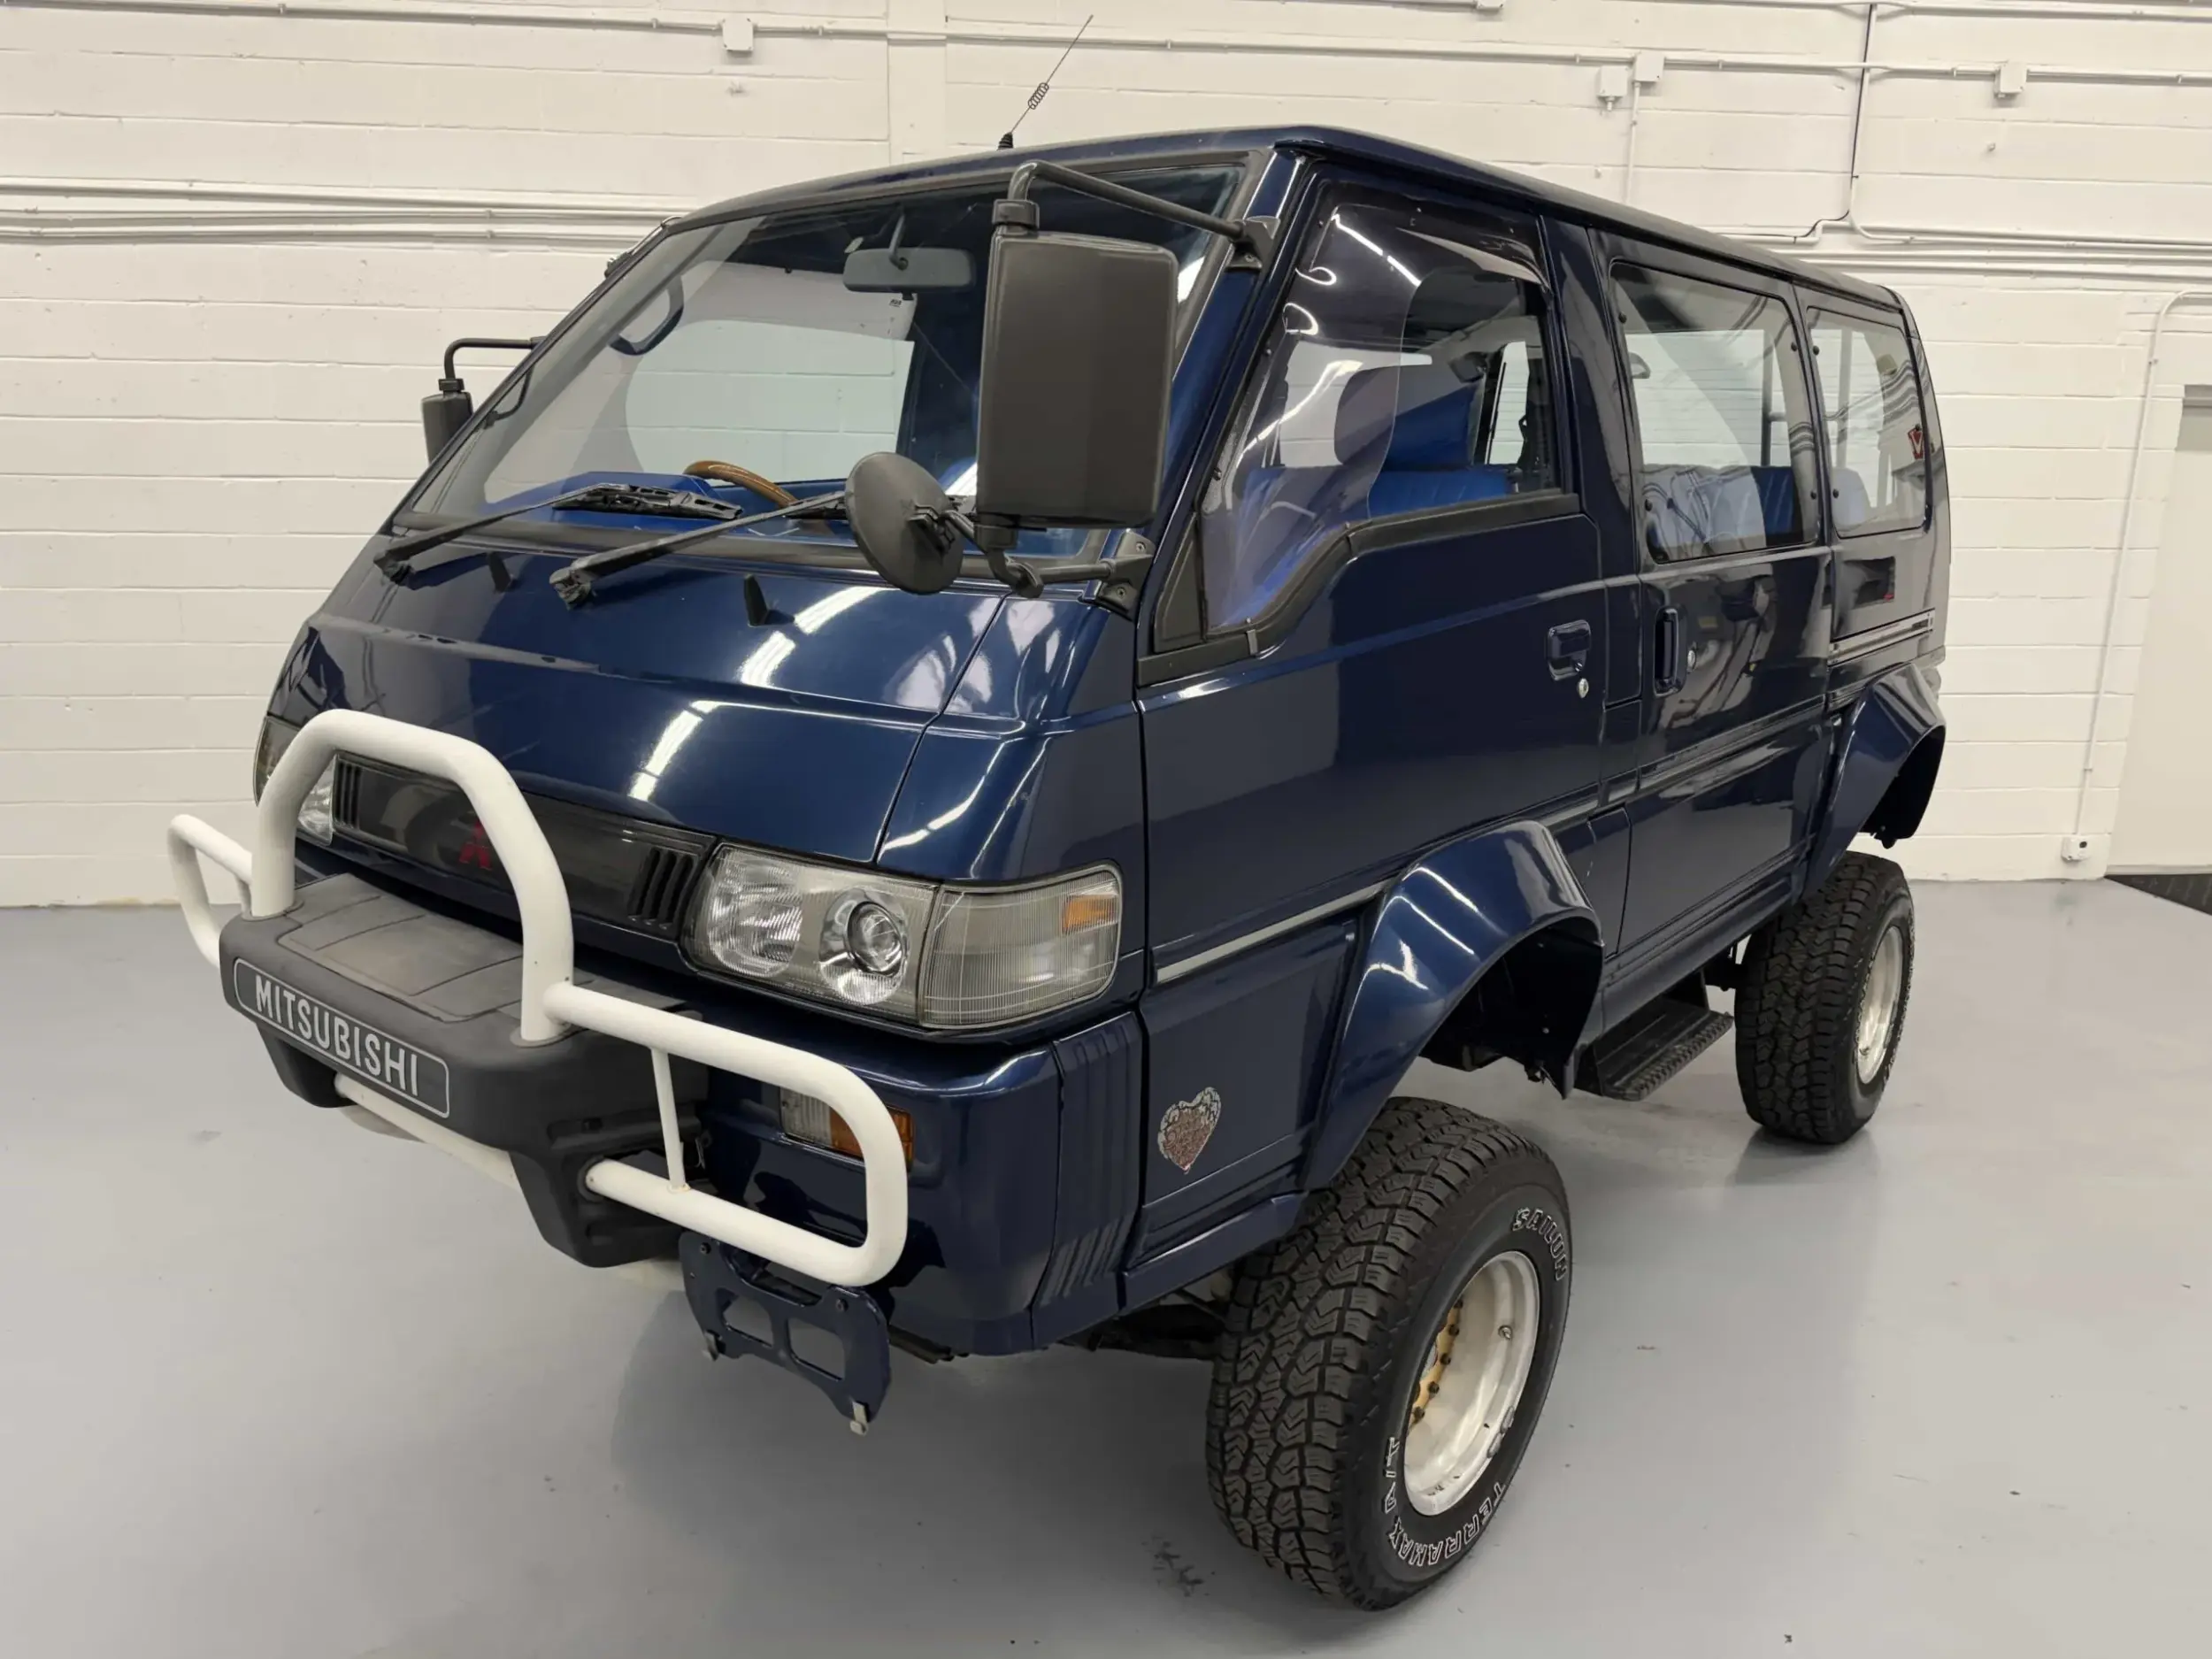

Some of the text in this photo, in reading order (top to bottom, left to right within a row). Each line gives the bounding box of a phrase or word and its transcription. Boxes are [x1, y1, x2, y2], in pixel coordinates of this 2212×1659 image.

[255, 974, 419, 1096] MITSUBISHI
[1512, 1207, 1568, 1281] SAILUN
[1388, 1481, 1507, 1567] TERRAMAX
